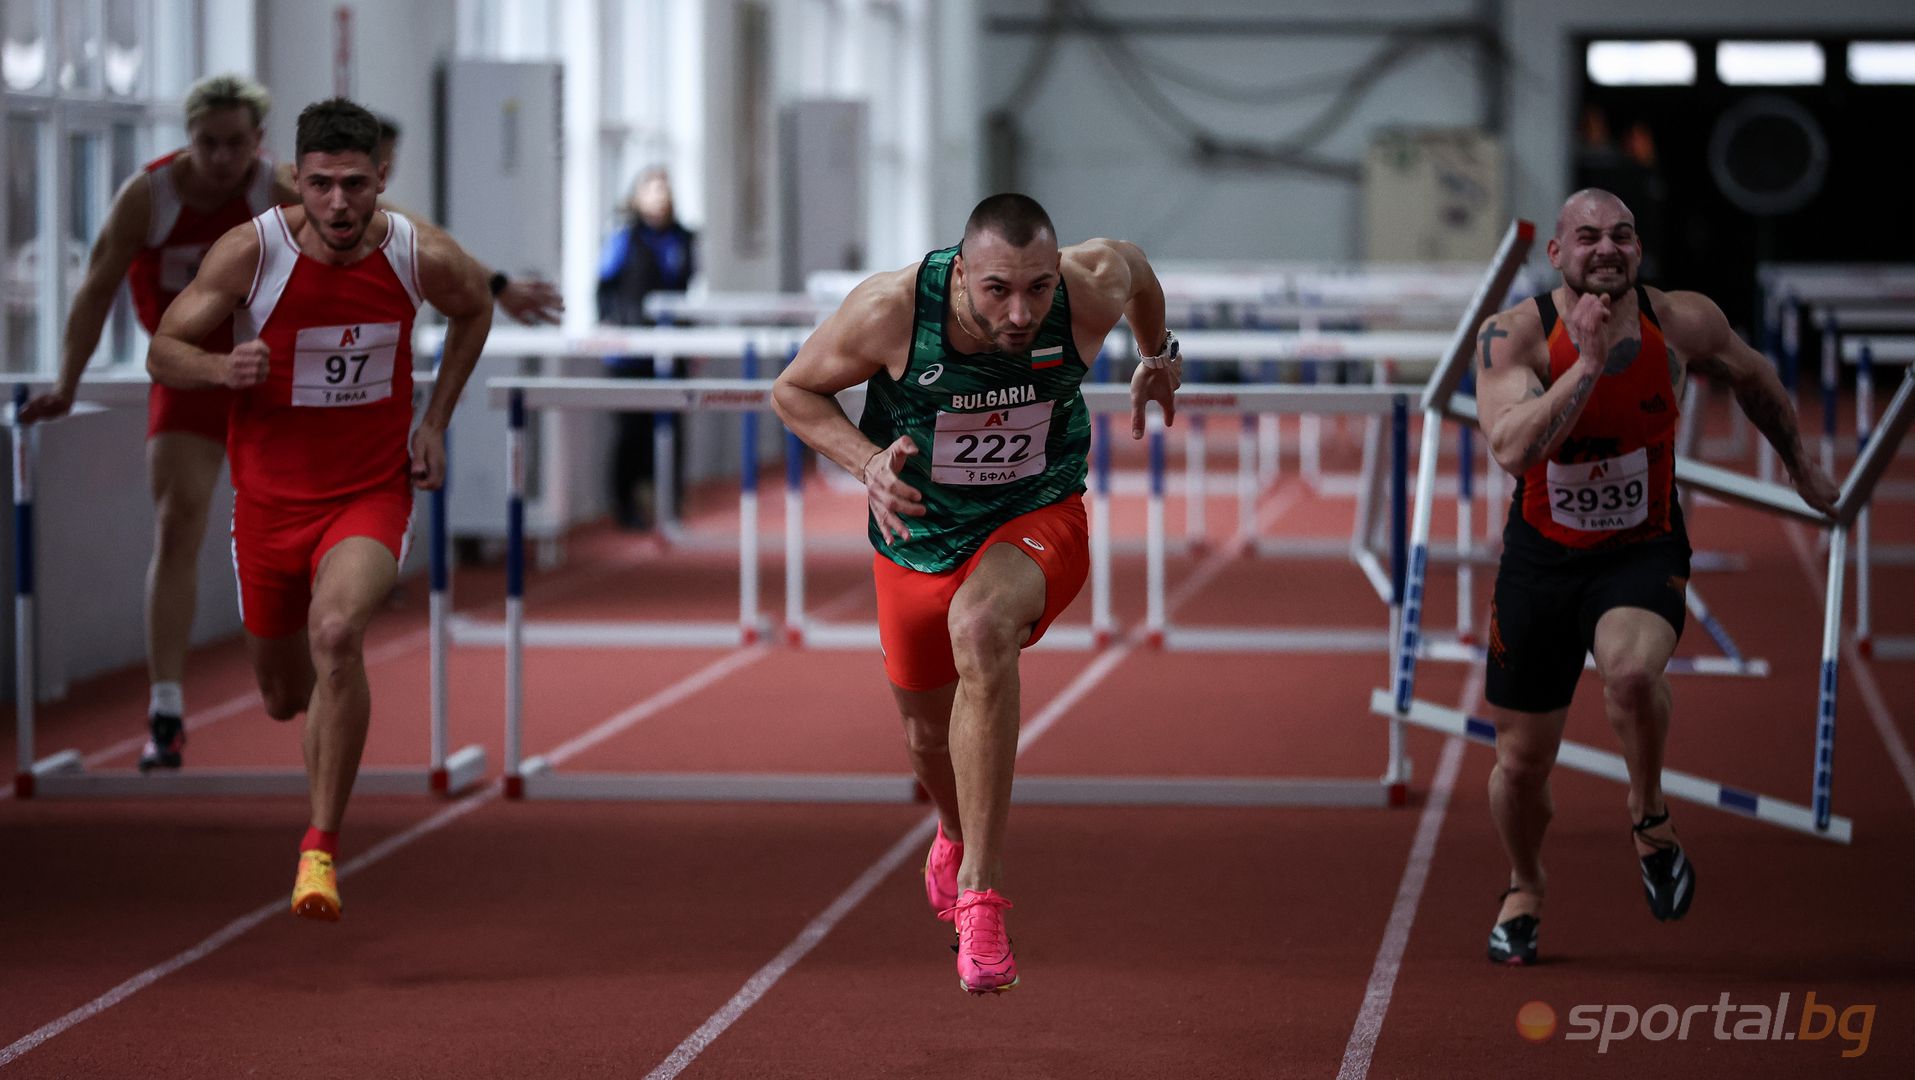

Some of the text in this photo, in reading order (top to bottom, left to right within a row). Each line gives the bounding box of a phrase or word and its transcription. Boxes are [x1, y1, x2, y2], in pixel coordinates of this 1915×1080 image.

[340, 326, 361, 347] A1
[325, 354, 369, 384] 97
[951, 384, 1037, 410] BULGARIA
[984, 410, 1009, 427] A1
[953, 434, 1032, 464] 222
[979, 470, 1017, 482] БФЛА
[1554, 480, 1643, 513] 2939
